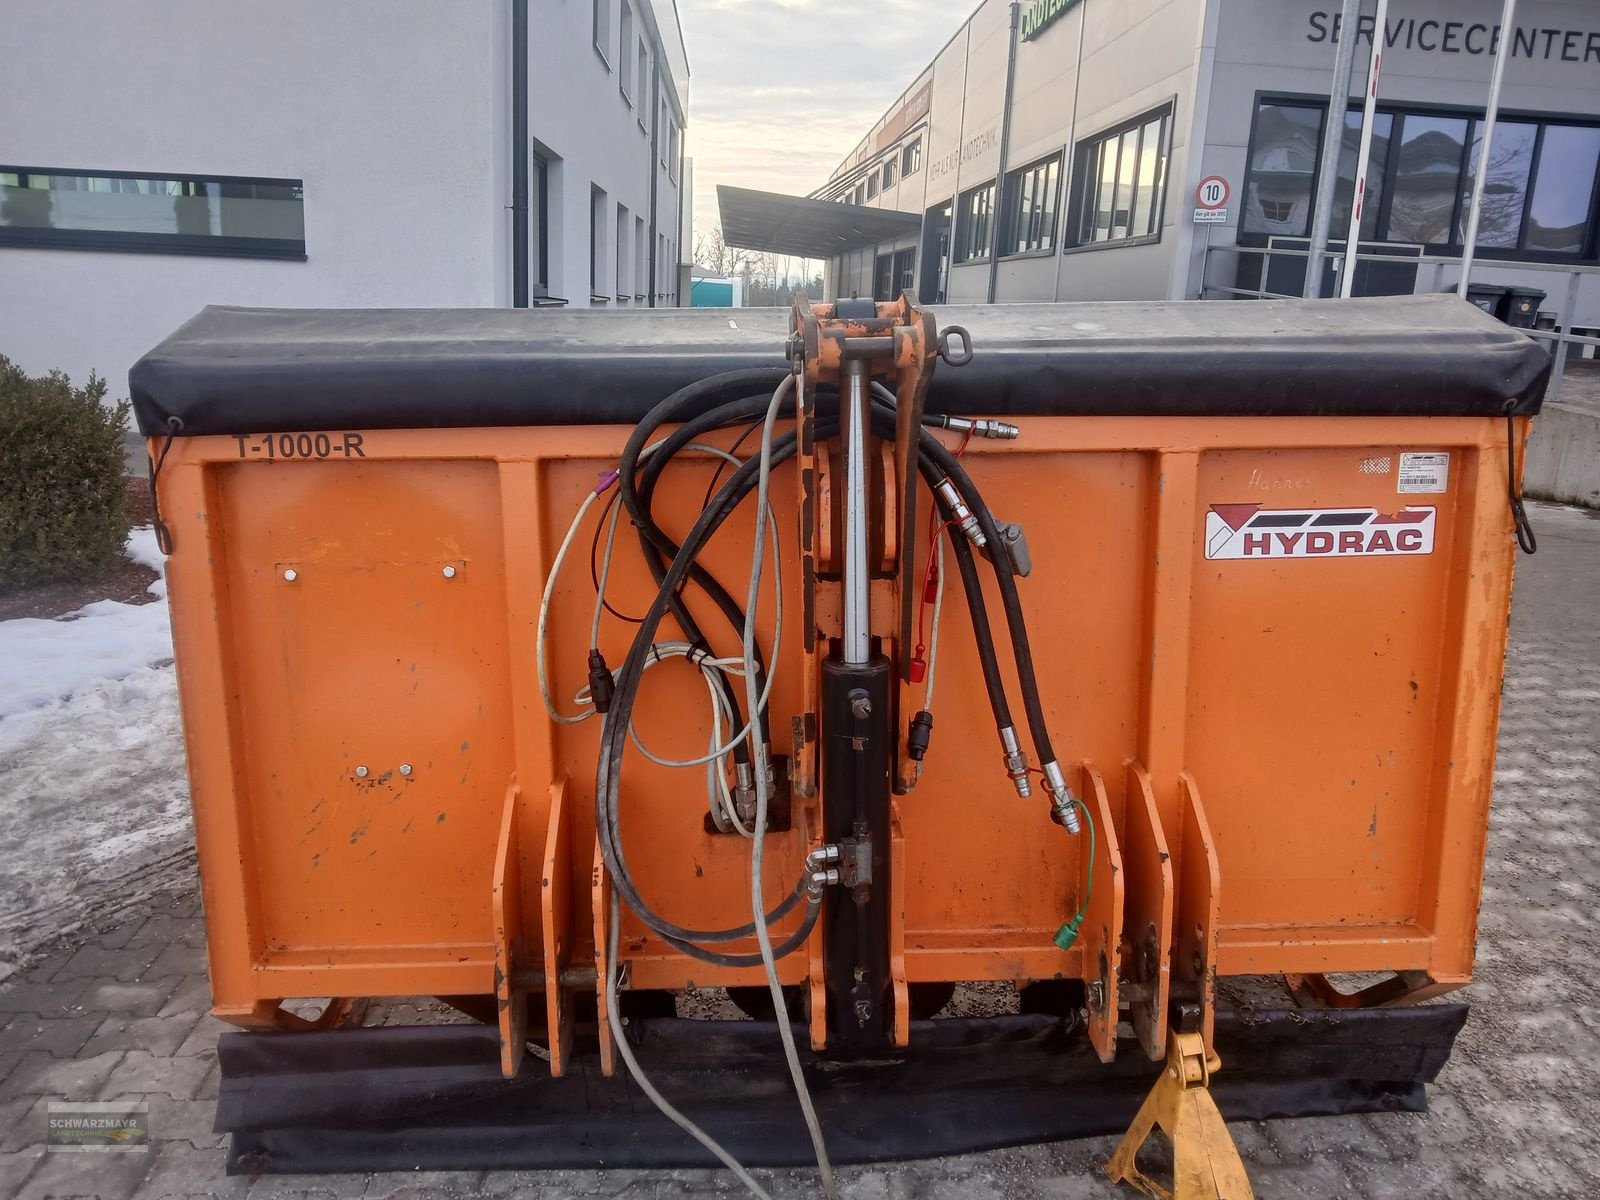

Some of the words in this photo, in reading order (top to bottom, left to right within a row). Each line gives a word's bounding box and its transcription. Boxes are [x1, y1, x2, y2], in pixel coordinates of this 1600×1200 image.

[1020, 0, 1069, 40] LANDTE
[1206, 184, 1220, 201] 10
[232, 433, 366, 458] T-1000-R
[1243, 529, 1423, 555] HYDRAC
